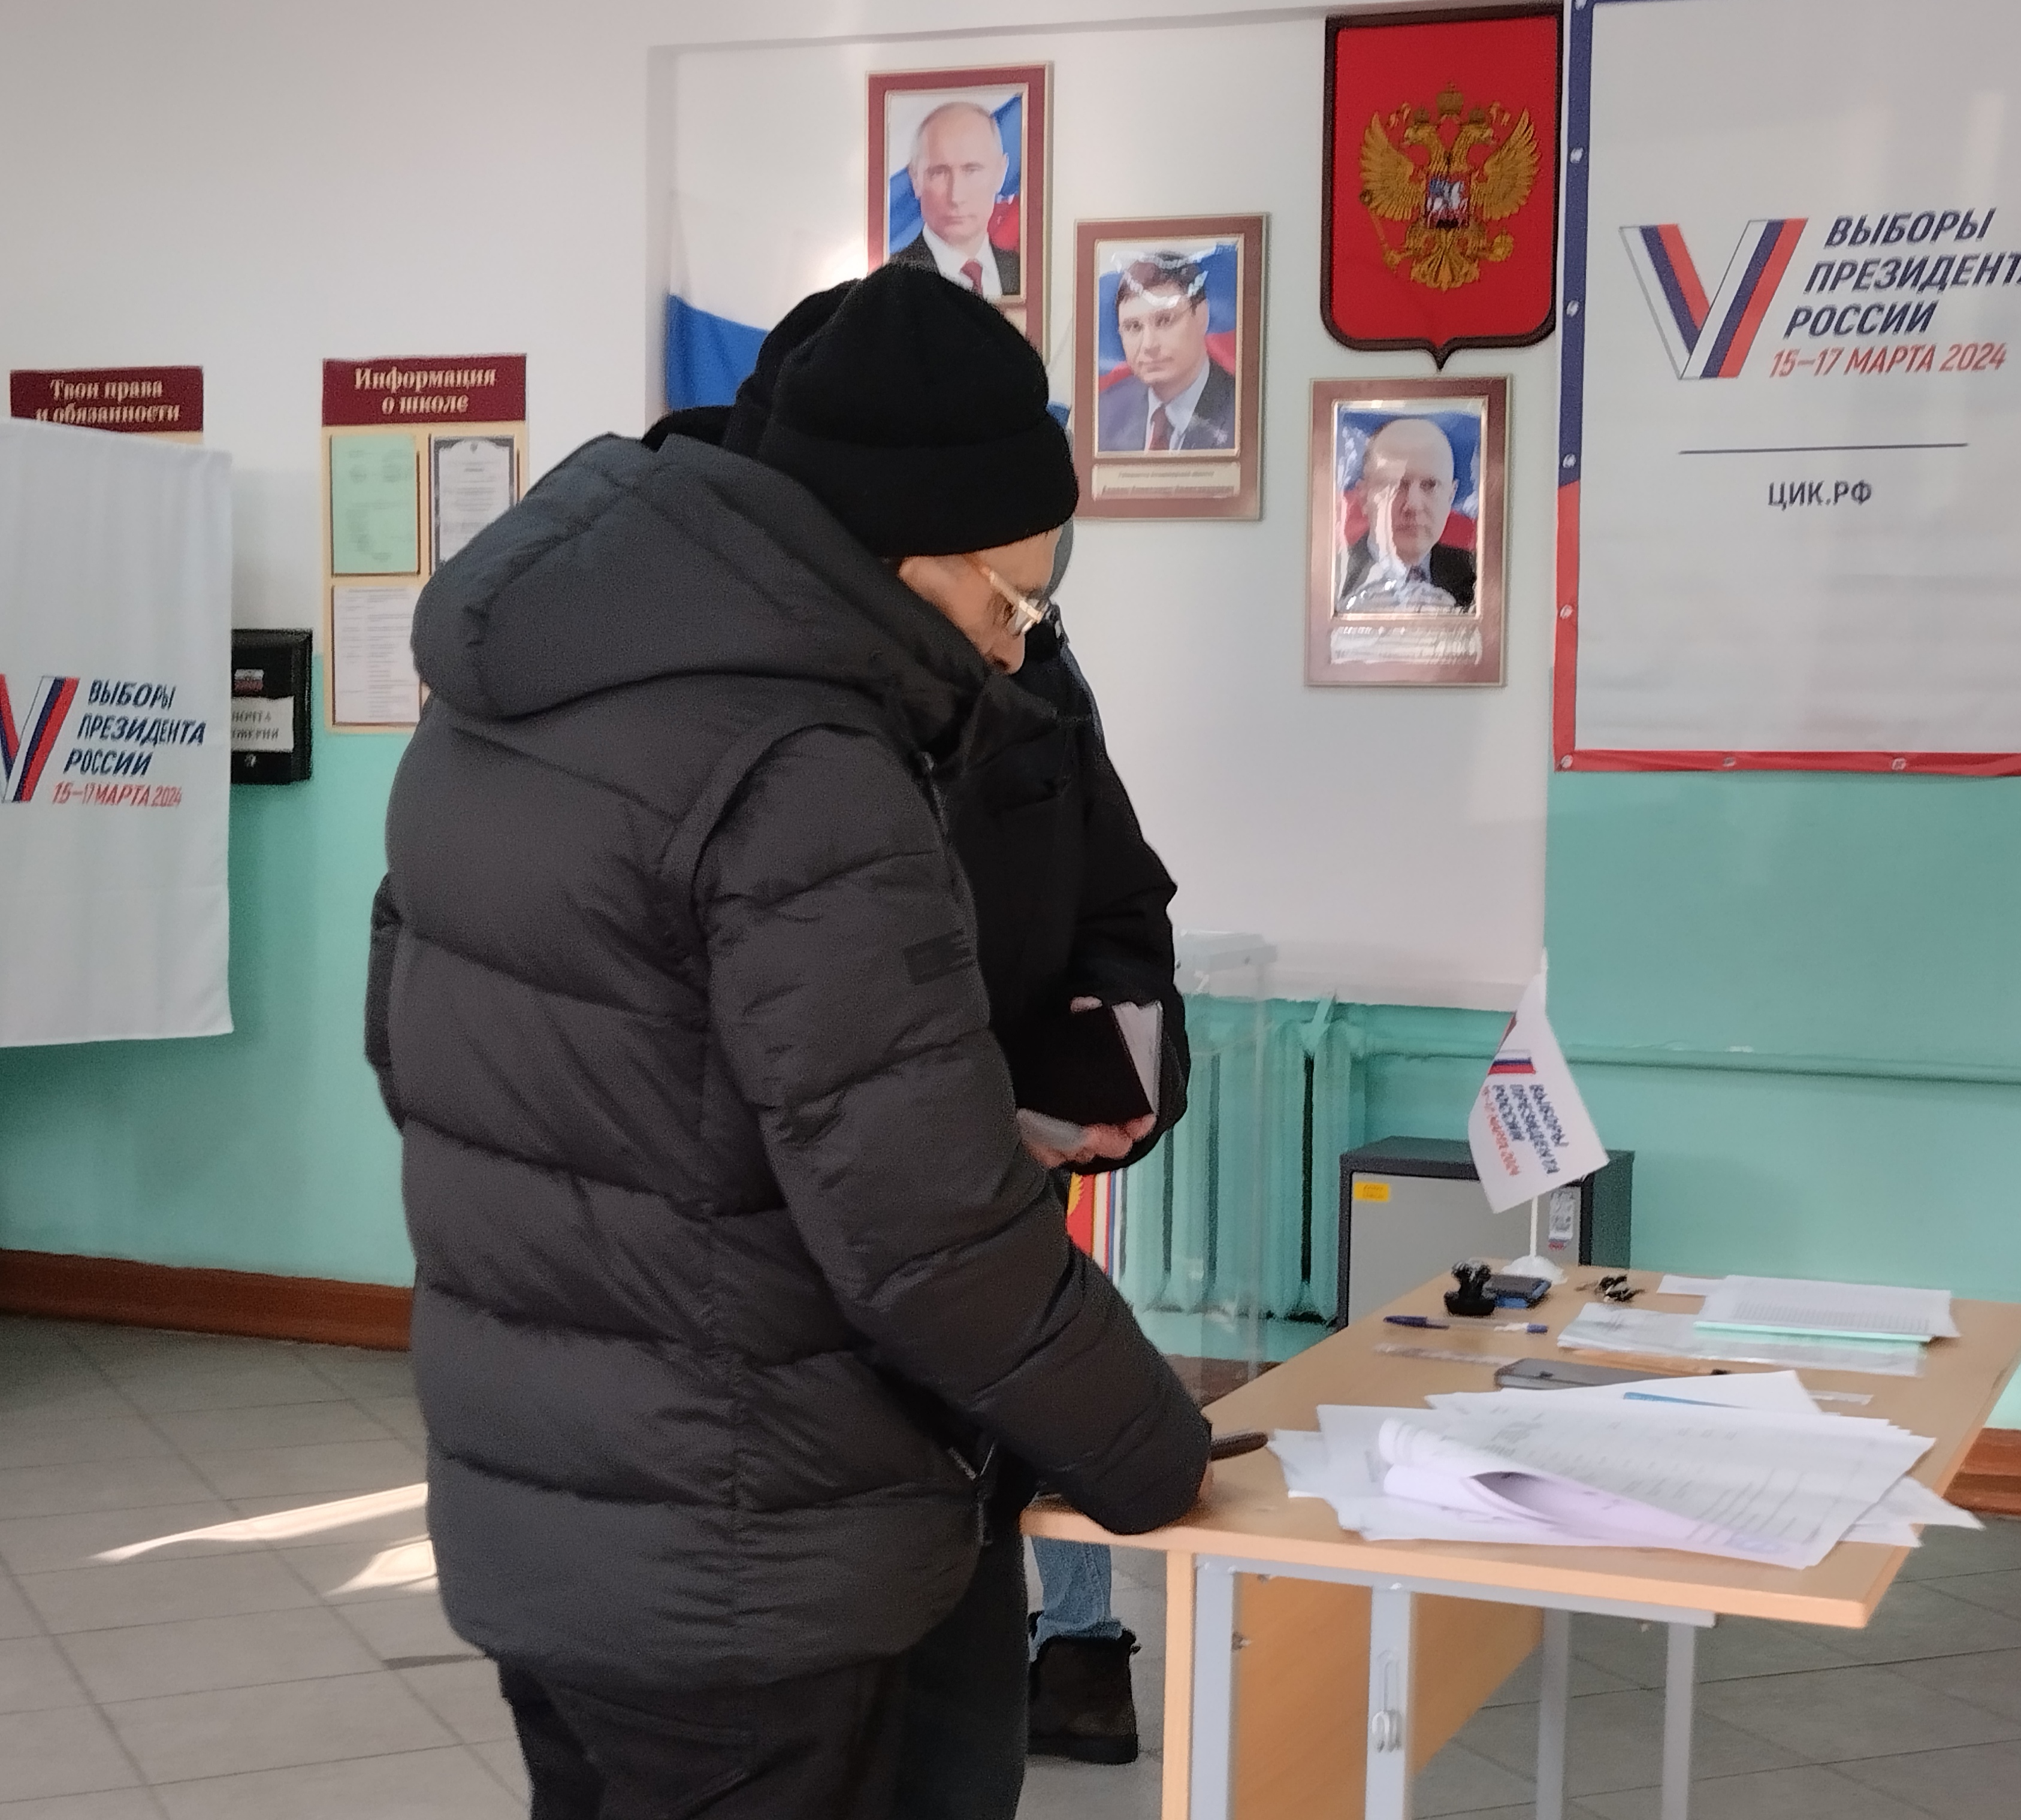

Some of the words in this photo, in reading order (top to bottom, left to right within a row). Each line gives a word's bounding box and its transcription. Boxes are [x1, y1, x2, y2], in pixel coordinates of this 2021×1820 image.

[1824, 207, 1997, 249] ВЫБОРЫ
[1803, 251, 2021, 294] ПРЕЗИДЕНТ
[1783, 300, 1940, 339] РОССИИ
[1844, 344, 1937, 376] МАРТА
[1939, 342, 2007, 372] 2024
[355, 366, 496, 393] Информация
[382, 397, 395, 415] о
[400, 395, 469, 415] школе
[1768, 479, 1872, 511] ЦИК.РФ
[88, 679, 176, 710] ВЫБОРЫ
[77, 713, 207, 746] ПРЕЗИДЕНТА
[63, 748, 153, 777] РОССИИ
[95, 783, 150, 806] МАРТА
[150, 786, 182, 807] 2024
